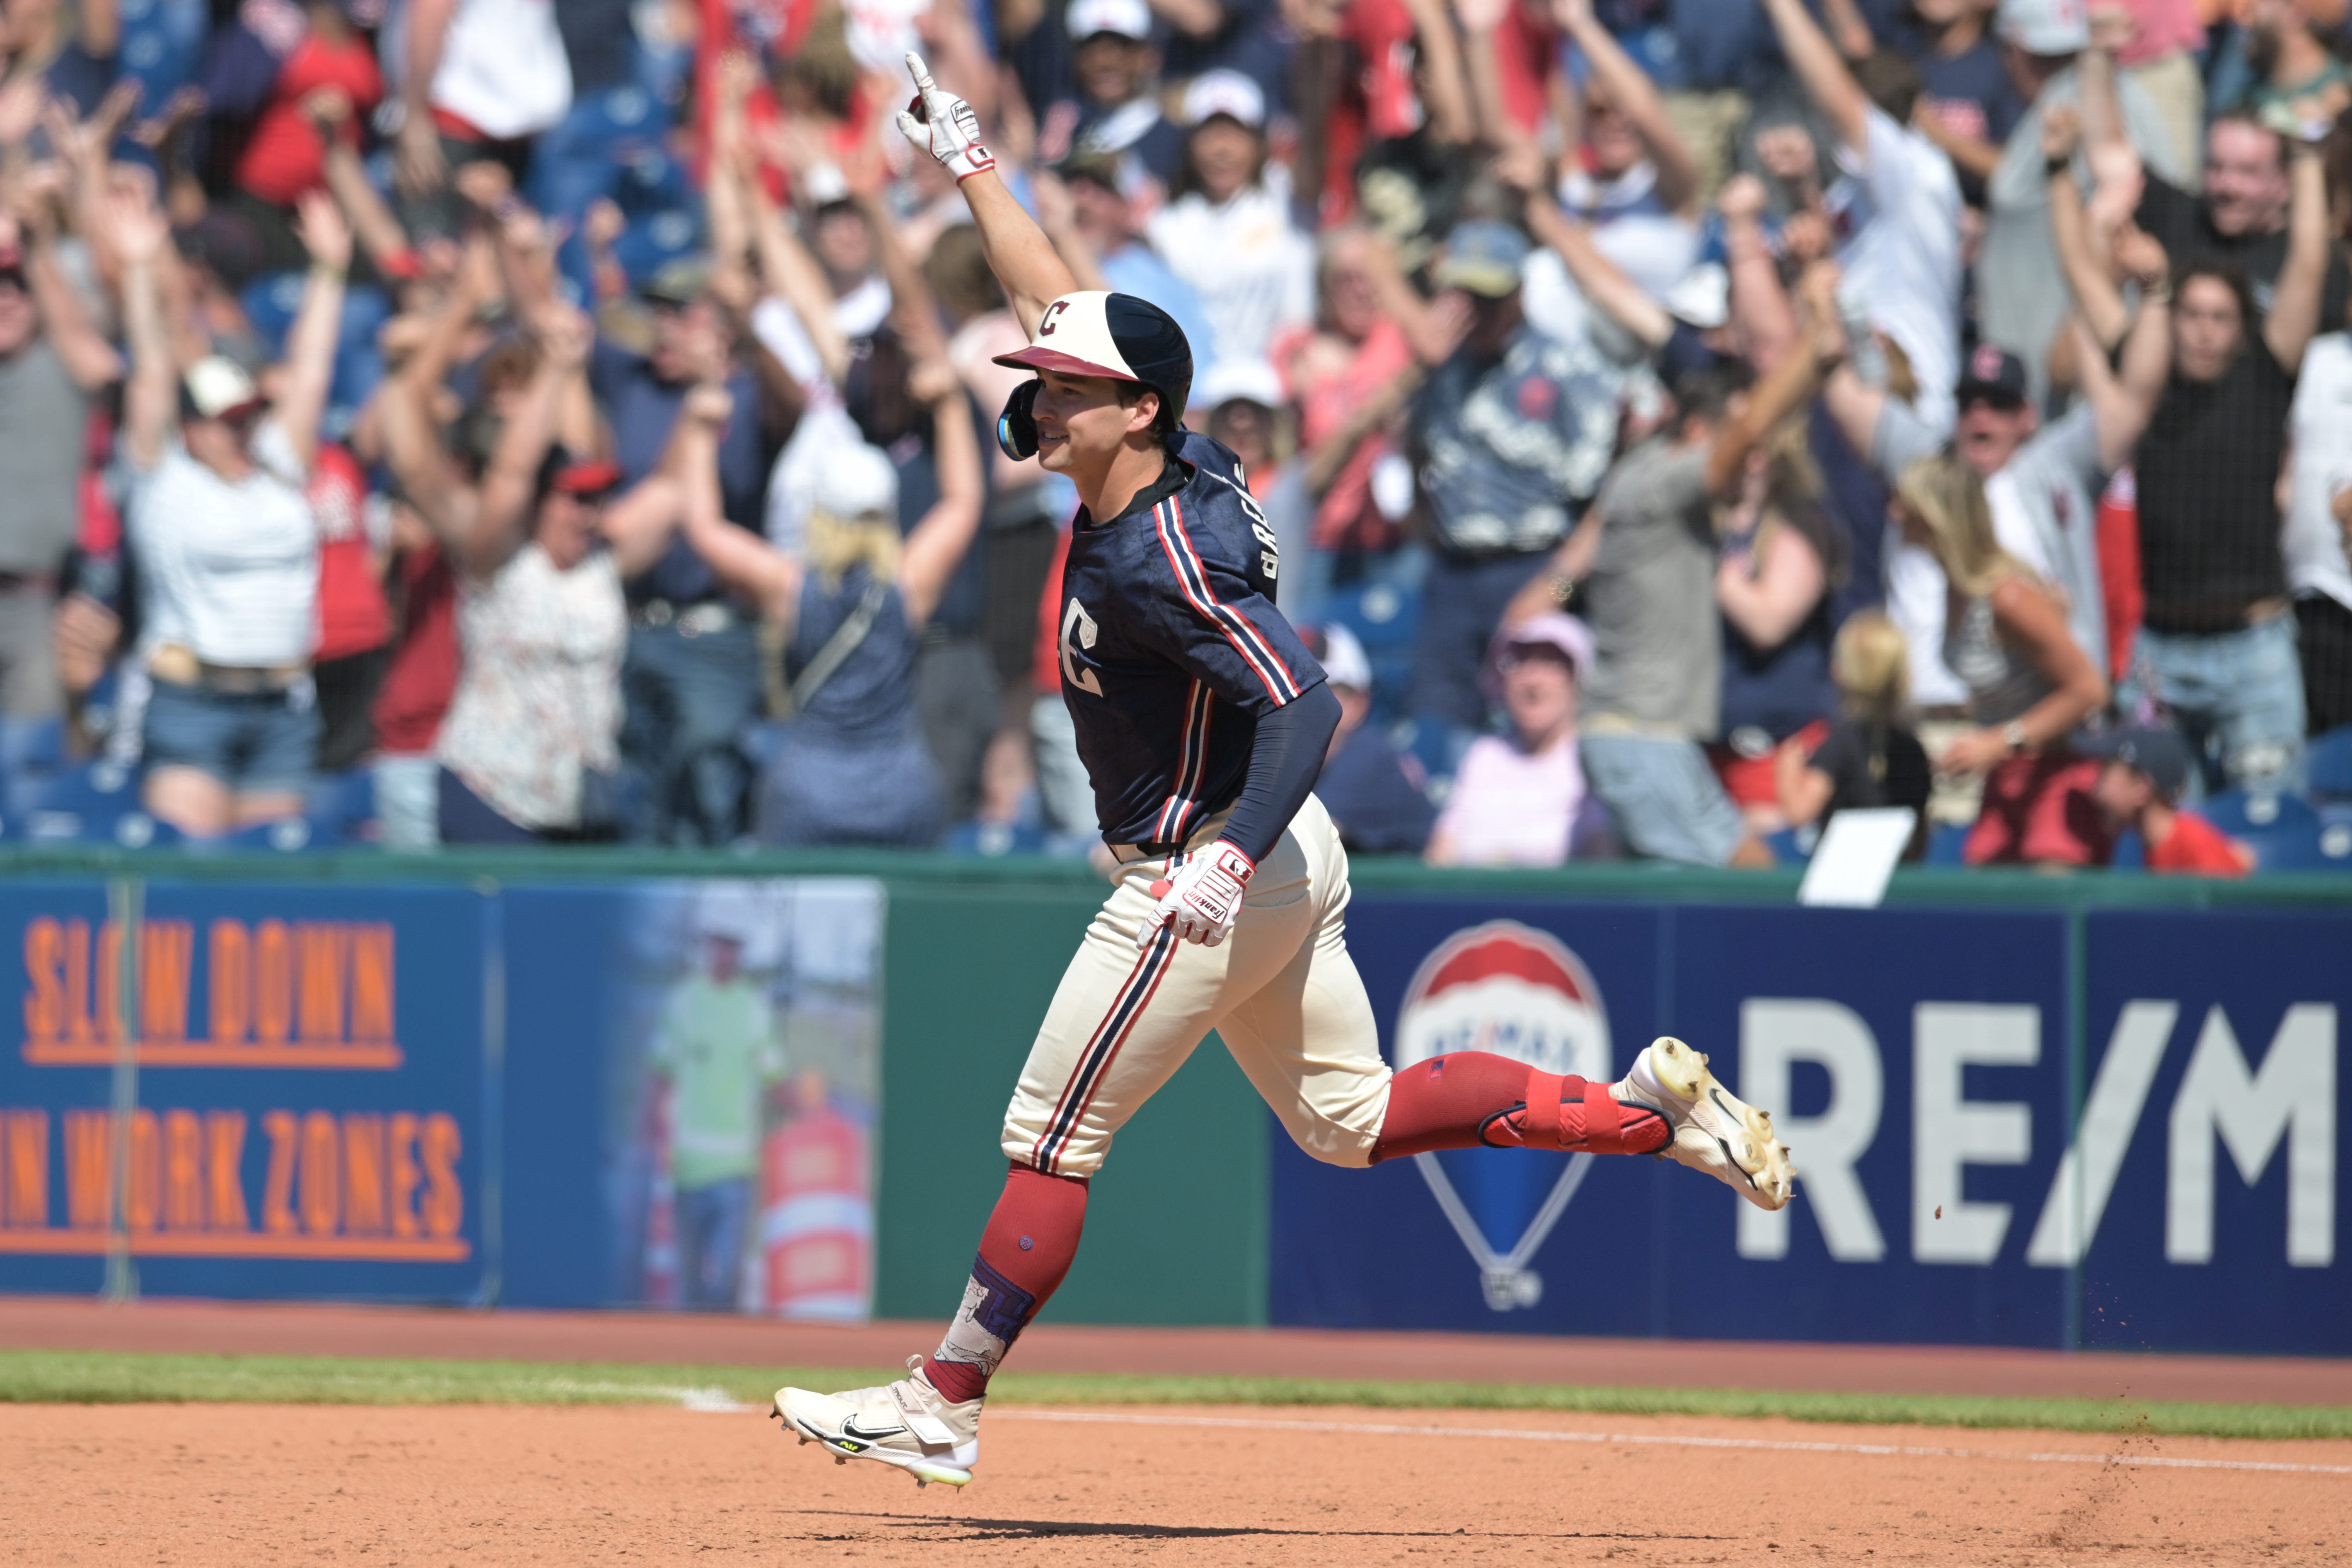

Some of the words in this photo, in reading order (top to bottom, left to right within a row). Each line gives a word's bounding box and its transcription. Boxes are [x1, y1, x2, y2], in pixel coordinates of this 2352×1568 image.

[1039, 300, 1070, 336] C
[209, 918, 395, 1042] DOWN
[0, 1108, 49, 1227] N
[64, 1108, 248, 1231] WORK
[262, 1109, 462, 1237] ZONES
